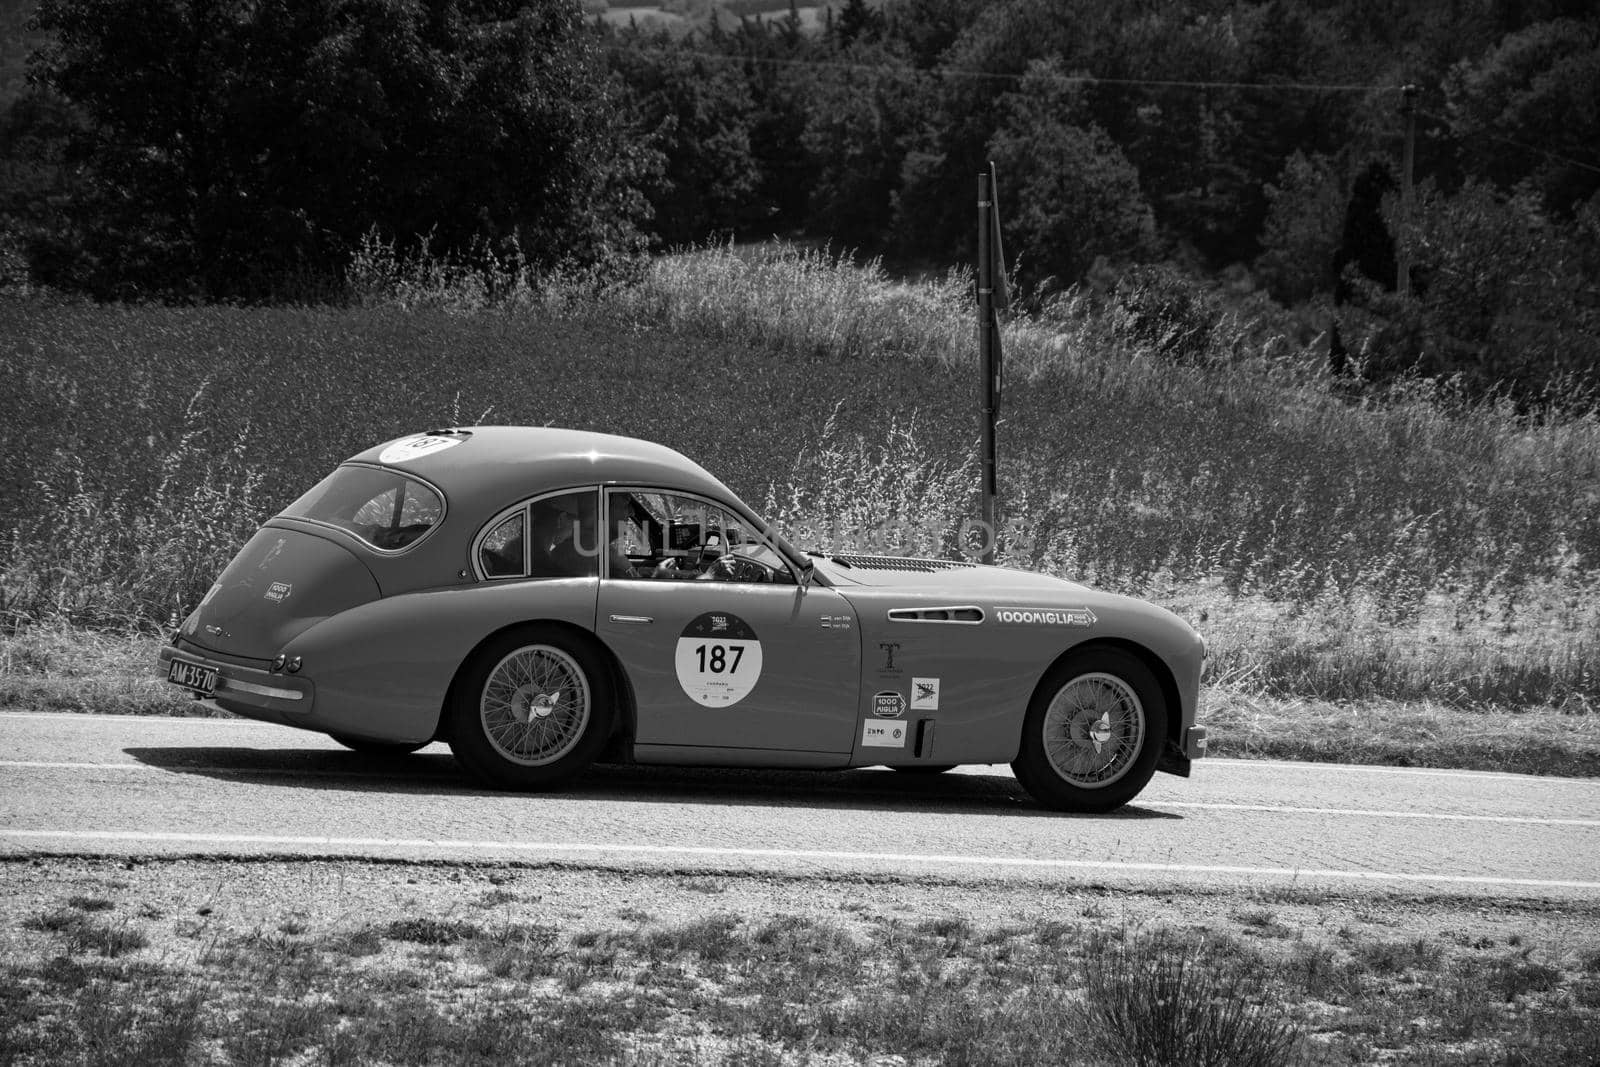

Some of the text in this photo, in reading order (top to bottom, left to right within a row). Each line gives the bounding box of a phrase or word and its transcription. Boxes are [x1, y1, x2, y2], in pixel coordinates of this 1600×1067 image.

[405, 437, 449, 448] 187
[996, 611, 1074, 624] 1000MIGLIA
[695, 644, 745, 674] 187
